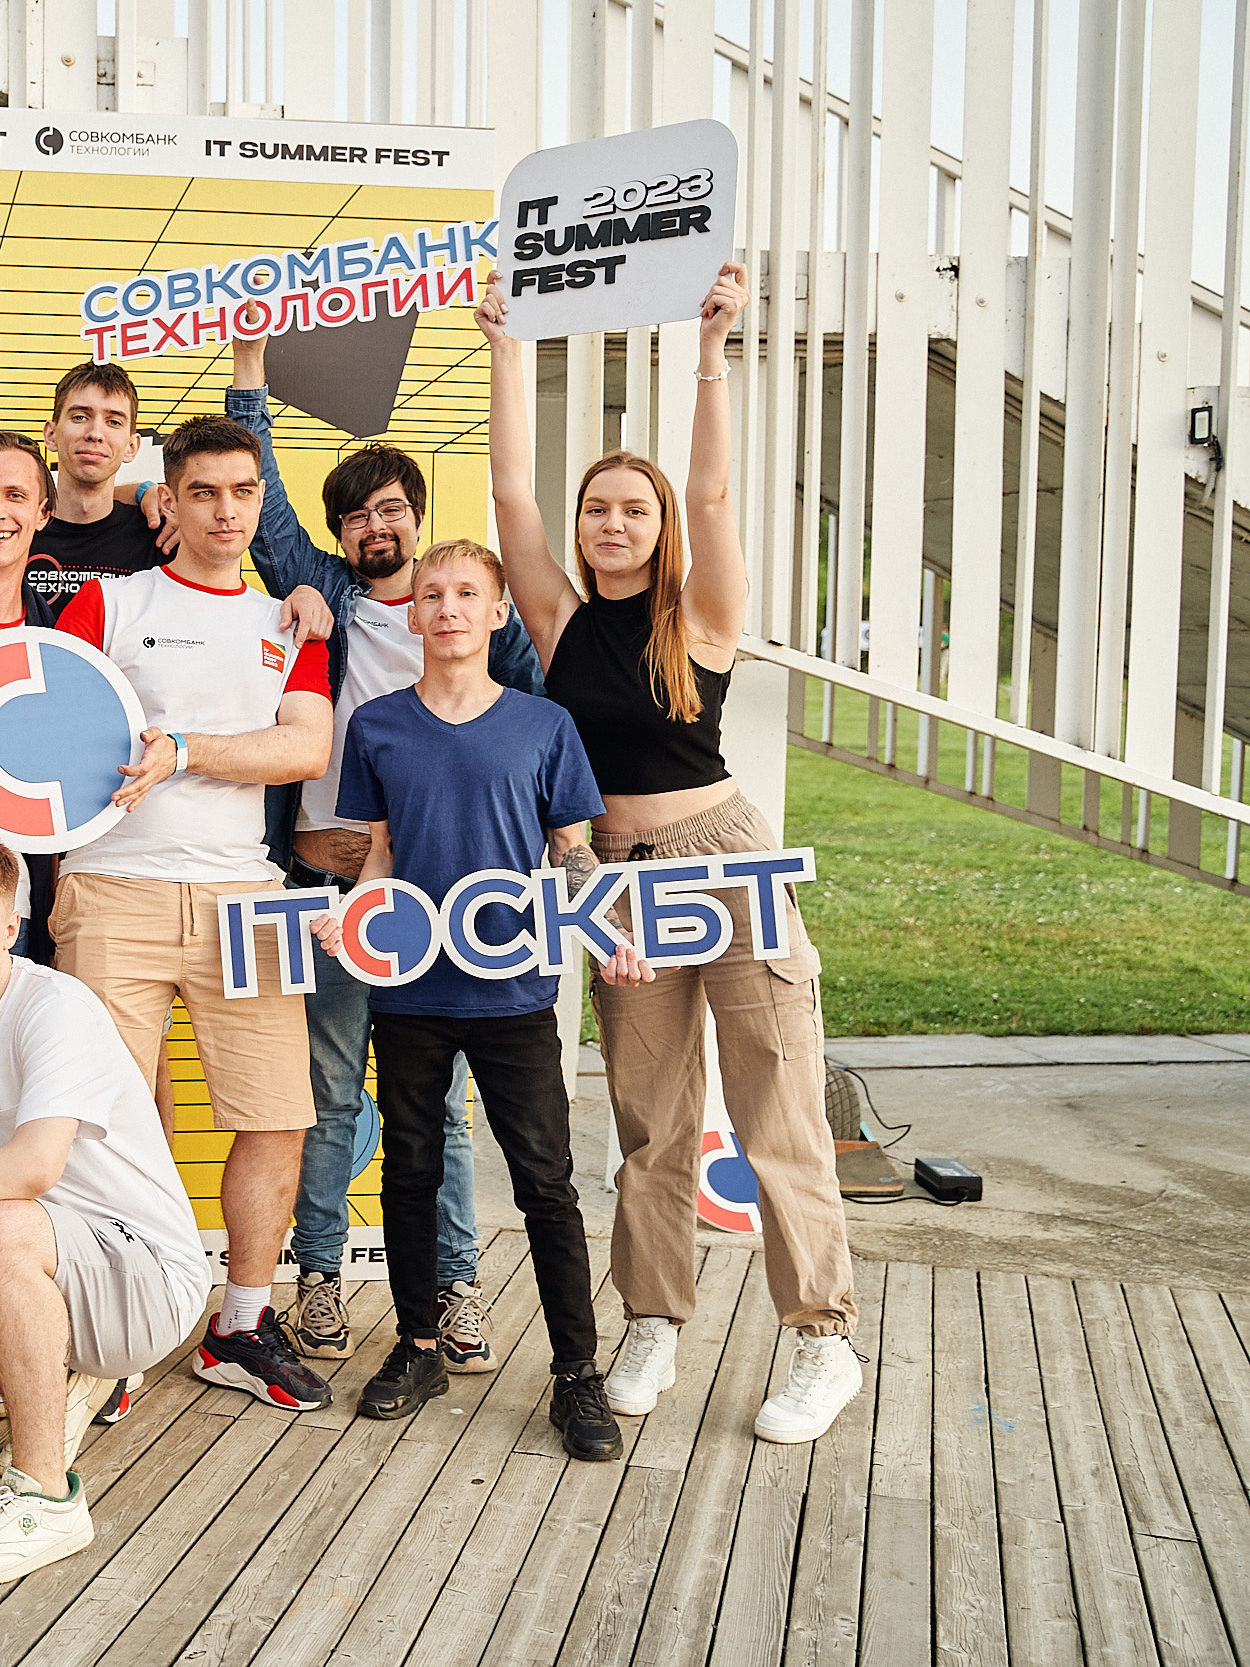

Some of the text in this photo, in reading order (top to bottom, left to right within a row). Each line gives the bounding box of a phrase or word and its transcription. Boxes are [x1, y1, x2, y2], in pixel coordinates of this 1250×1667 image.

[68, 130, 178, 148] СОВКОМБАНК
[69, 143, 151, 157] ТЕХНОЛОГИИ
[205, 139, 450, 167] IT SUMMER FEST
[517, 168, 713, 228] IT 2023
[513, 204, 712, 261] SUMMER
[84, 220, 499, 323] СОВКОМБАНК
[511, 254, 626, 297] FEST
[84, 267, 474, 361] ТЕХНОЛОГИИ
[350, 1247, 385, 1264] FE
